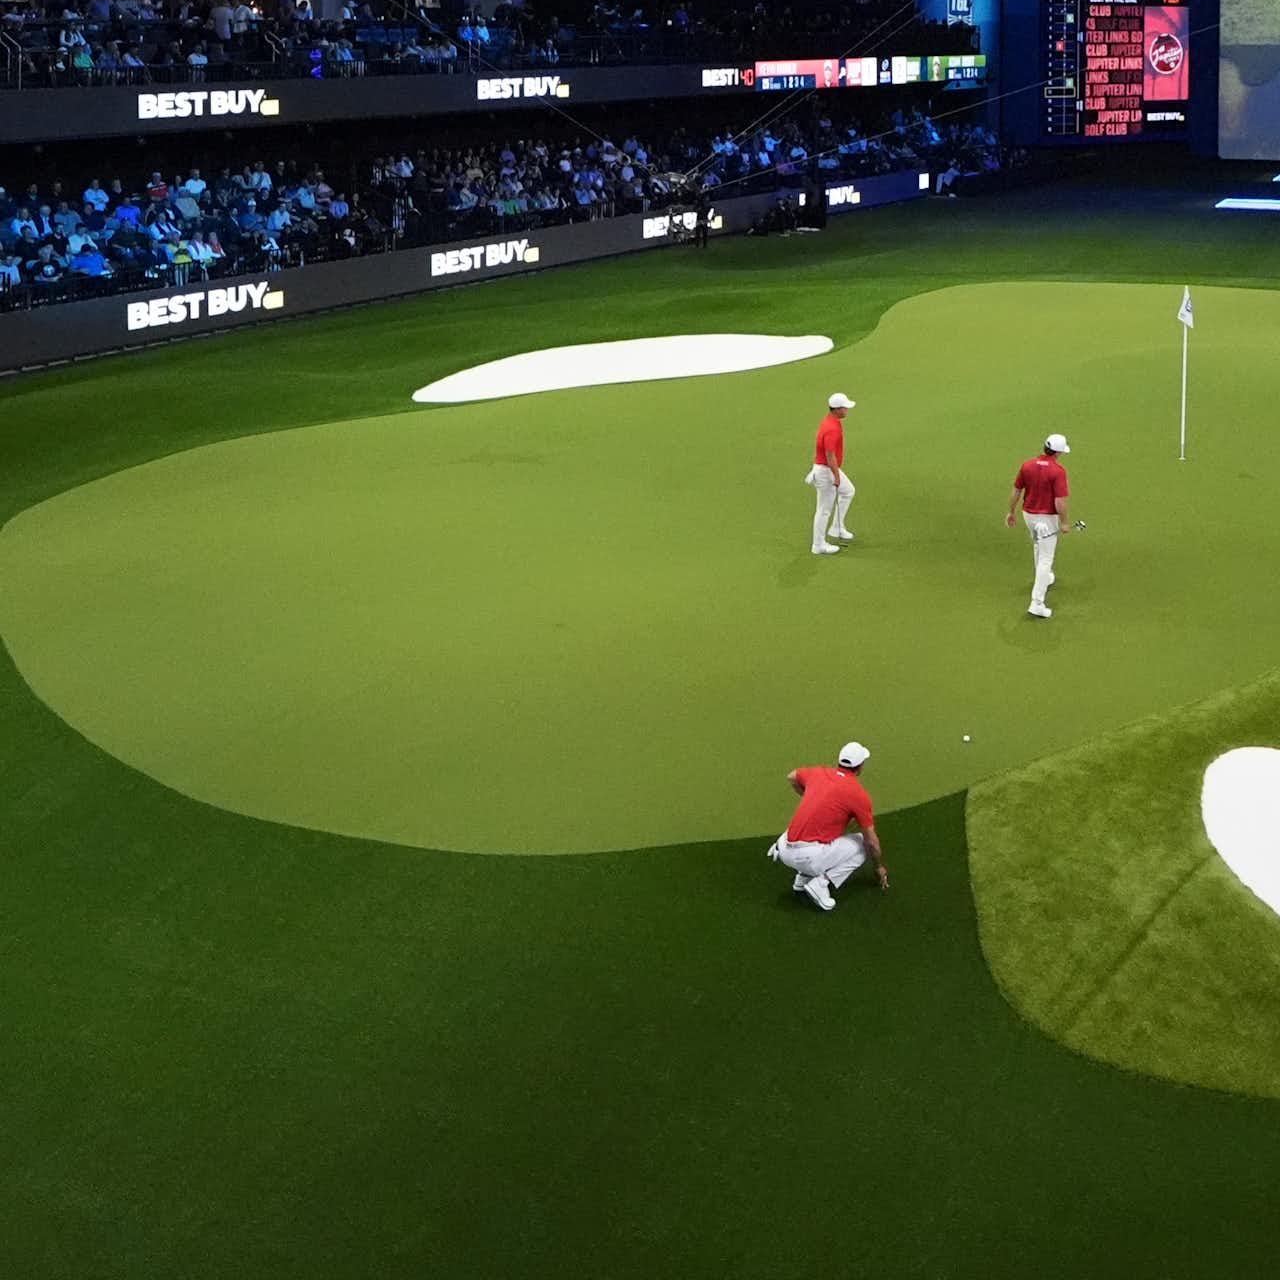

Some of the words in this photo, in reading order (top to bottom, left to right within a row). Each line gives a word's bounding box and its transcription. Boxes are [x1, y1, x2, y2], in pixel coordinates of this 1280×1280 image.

[1089, 5, 1111, 16] CLUB
[1105, 31, 1129, 43] LINKS
[1086, 44, 1107, 56] CLUB
[1087, 58, 1120, 70] JUPITER
[702, 69, 735, 87] BEST
[477, 78, 524, 101] BEST
[524, 76, 569, 98] BUY
[1093, 84, 1125, 96] JUPITER
[138, 91, 209, 120] BEST
[210, 88, 264, 116] BUY
[1097, 111, 1129, 122] JUPITER
[1106, 123, 1127, 136] CLUB
[430, 246, 484, 277] BEST
[486, 239, 539, 267] BUY
[128, 292, 205, 331] BEST
[207, 280, 269, 317] BUY
